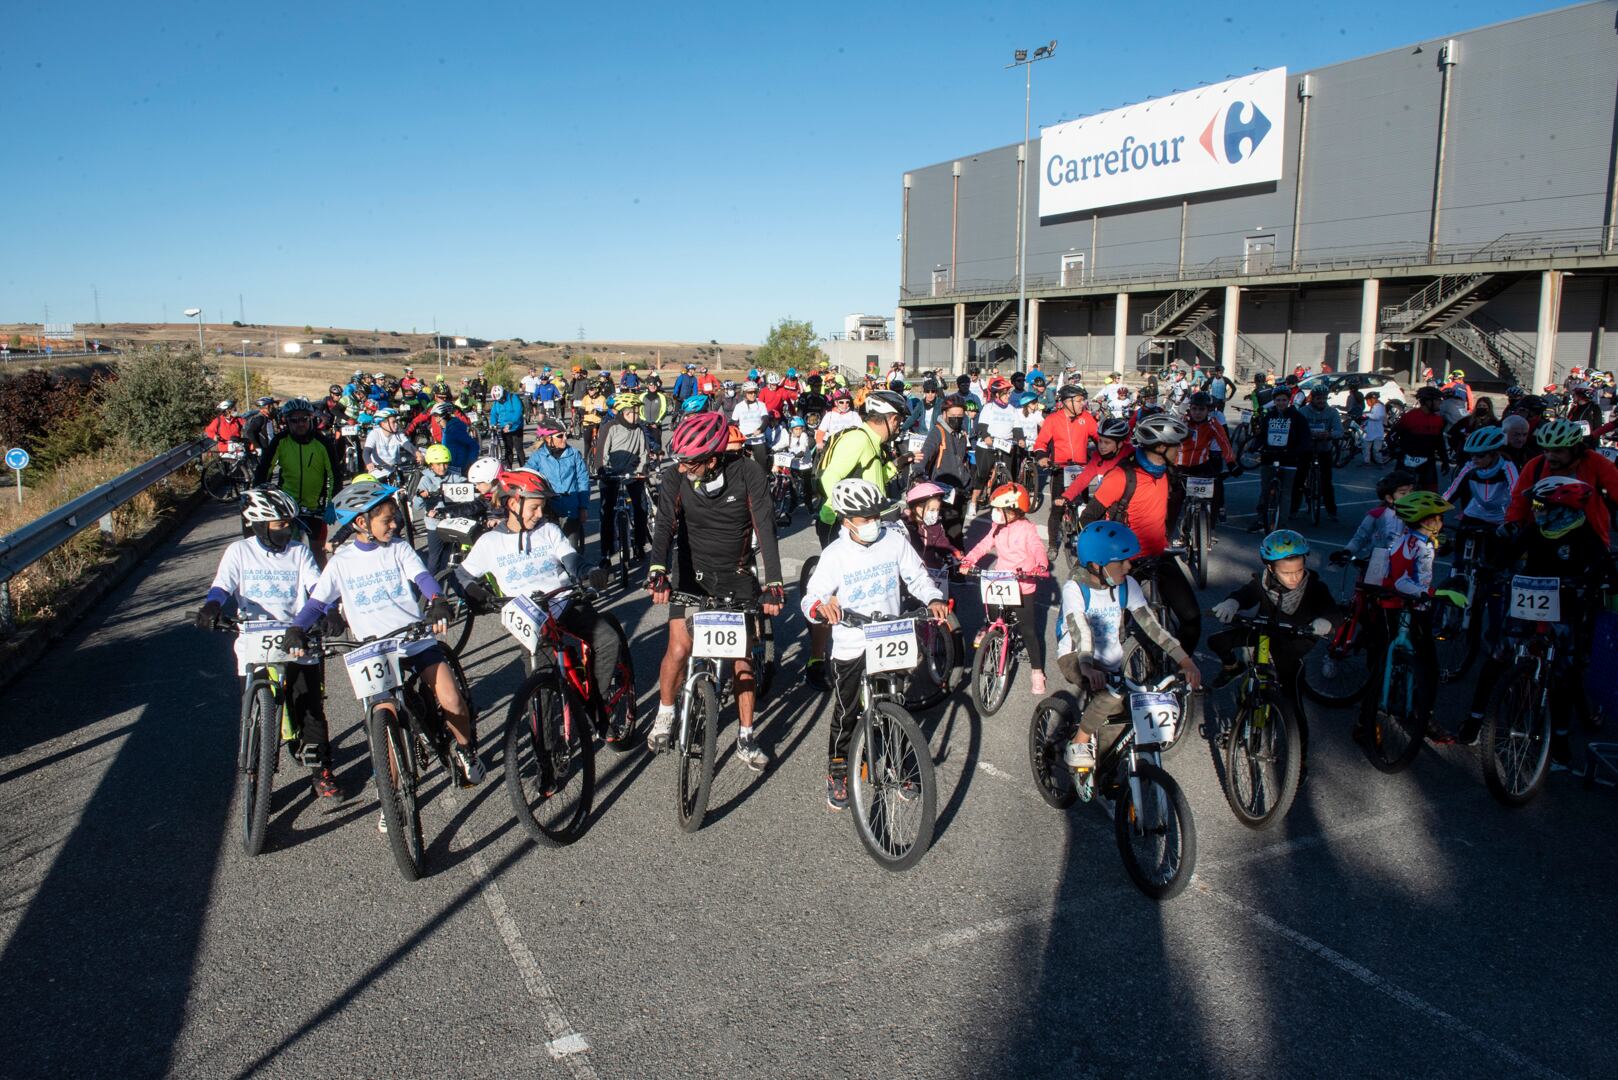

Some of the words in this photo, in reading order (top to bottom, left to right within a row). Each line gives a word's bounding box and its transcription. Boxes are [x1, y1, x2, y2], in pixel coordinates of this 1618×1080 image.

[1047, 136, 1185, 187] Carrefour
[450, 487, 468, 495] 169
[989, 584, 1010, 596] 121
[1517, 593, 1550, 610] 212
[509, 611, 532, 638] 136
[262, 634, 285, 650] 59
[704, 630, 737, 646] 108
[876, 640, 909, 659] 129
[361, 658, 391, 682] 131
